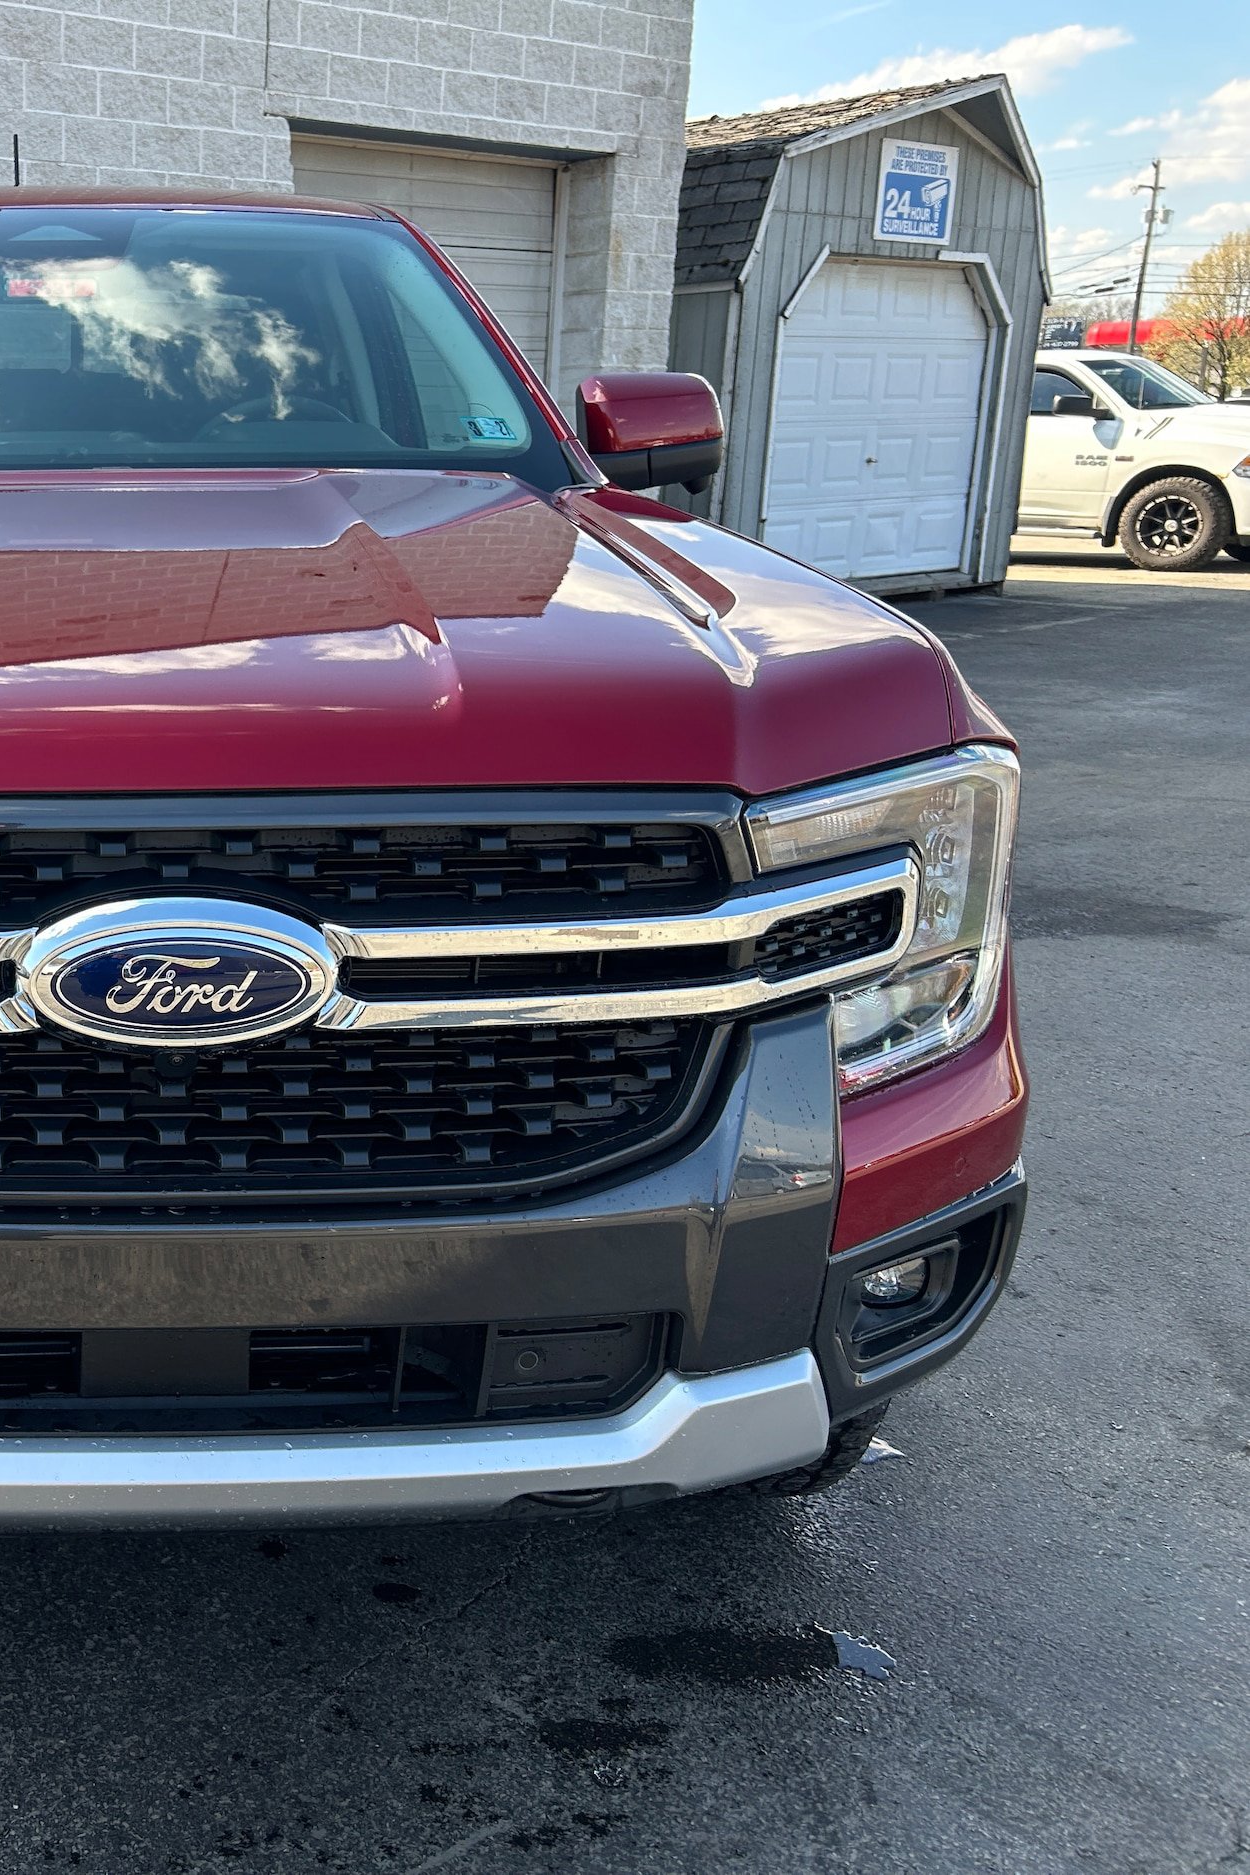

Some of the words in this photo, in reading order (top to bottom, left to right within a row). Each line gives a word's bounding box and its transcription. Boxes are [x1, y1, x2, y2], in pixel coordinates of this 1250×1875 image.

[896, 146, 915, 159] THESE
[916, 149, 946, 163] PREMISES
[891, 159, 904, 170] ARE
[905, 160, 939, 175] PROTECTED
[940, 165, 948, 176] BY
[884, 188, 911, 218] 24
[911, 208, 930, 220] HOUR
[883, 219, 939, 235] SURVEILLANCE
[105, 954, 258, 1013] Ford
